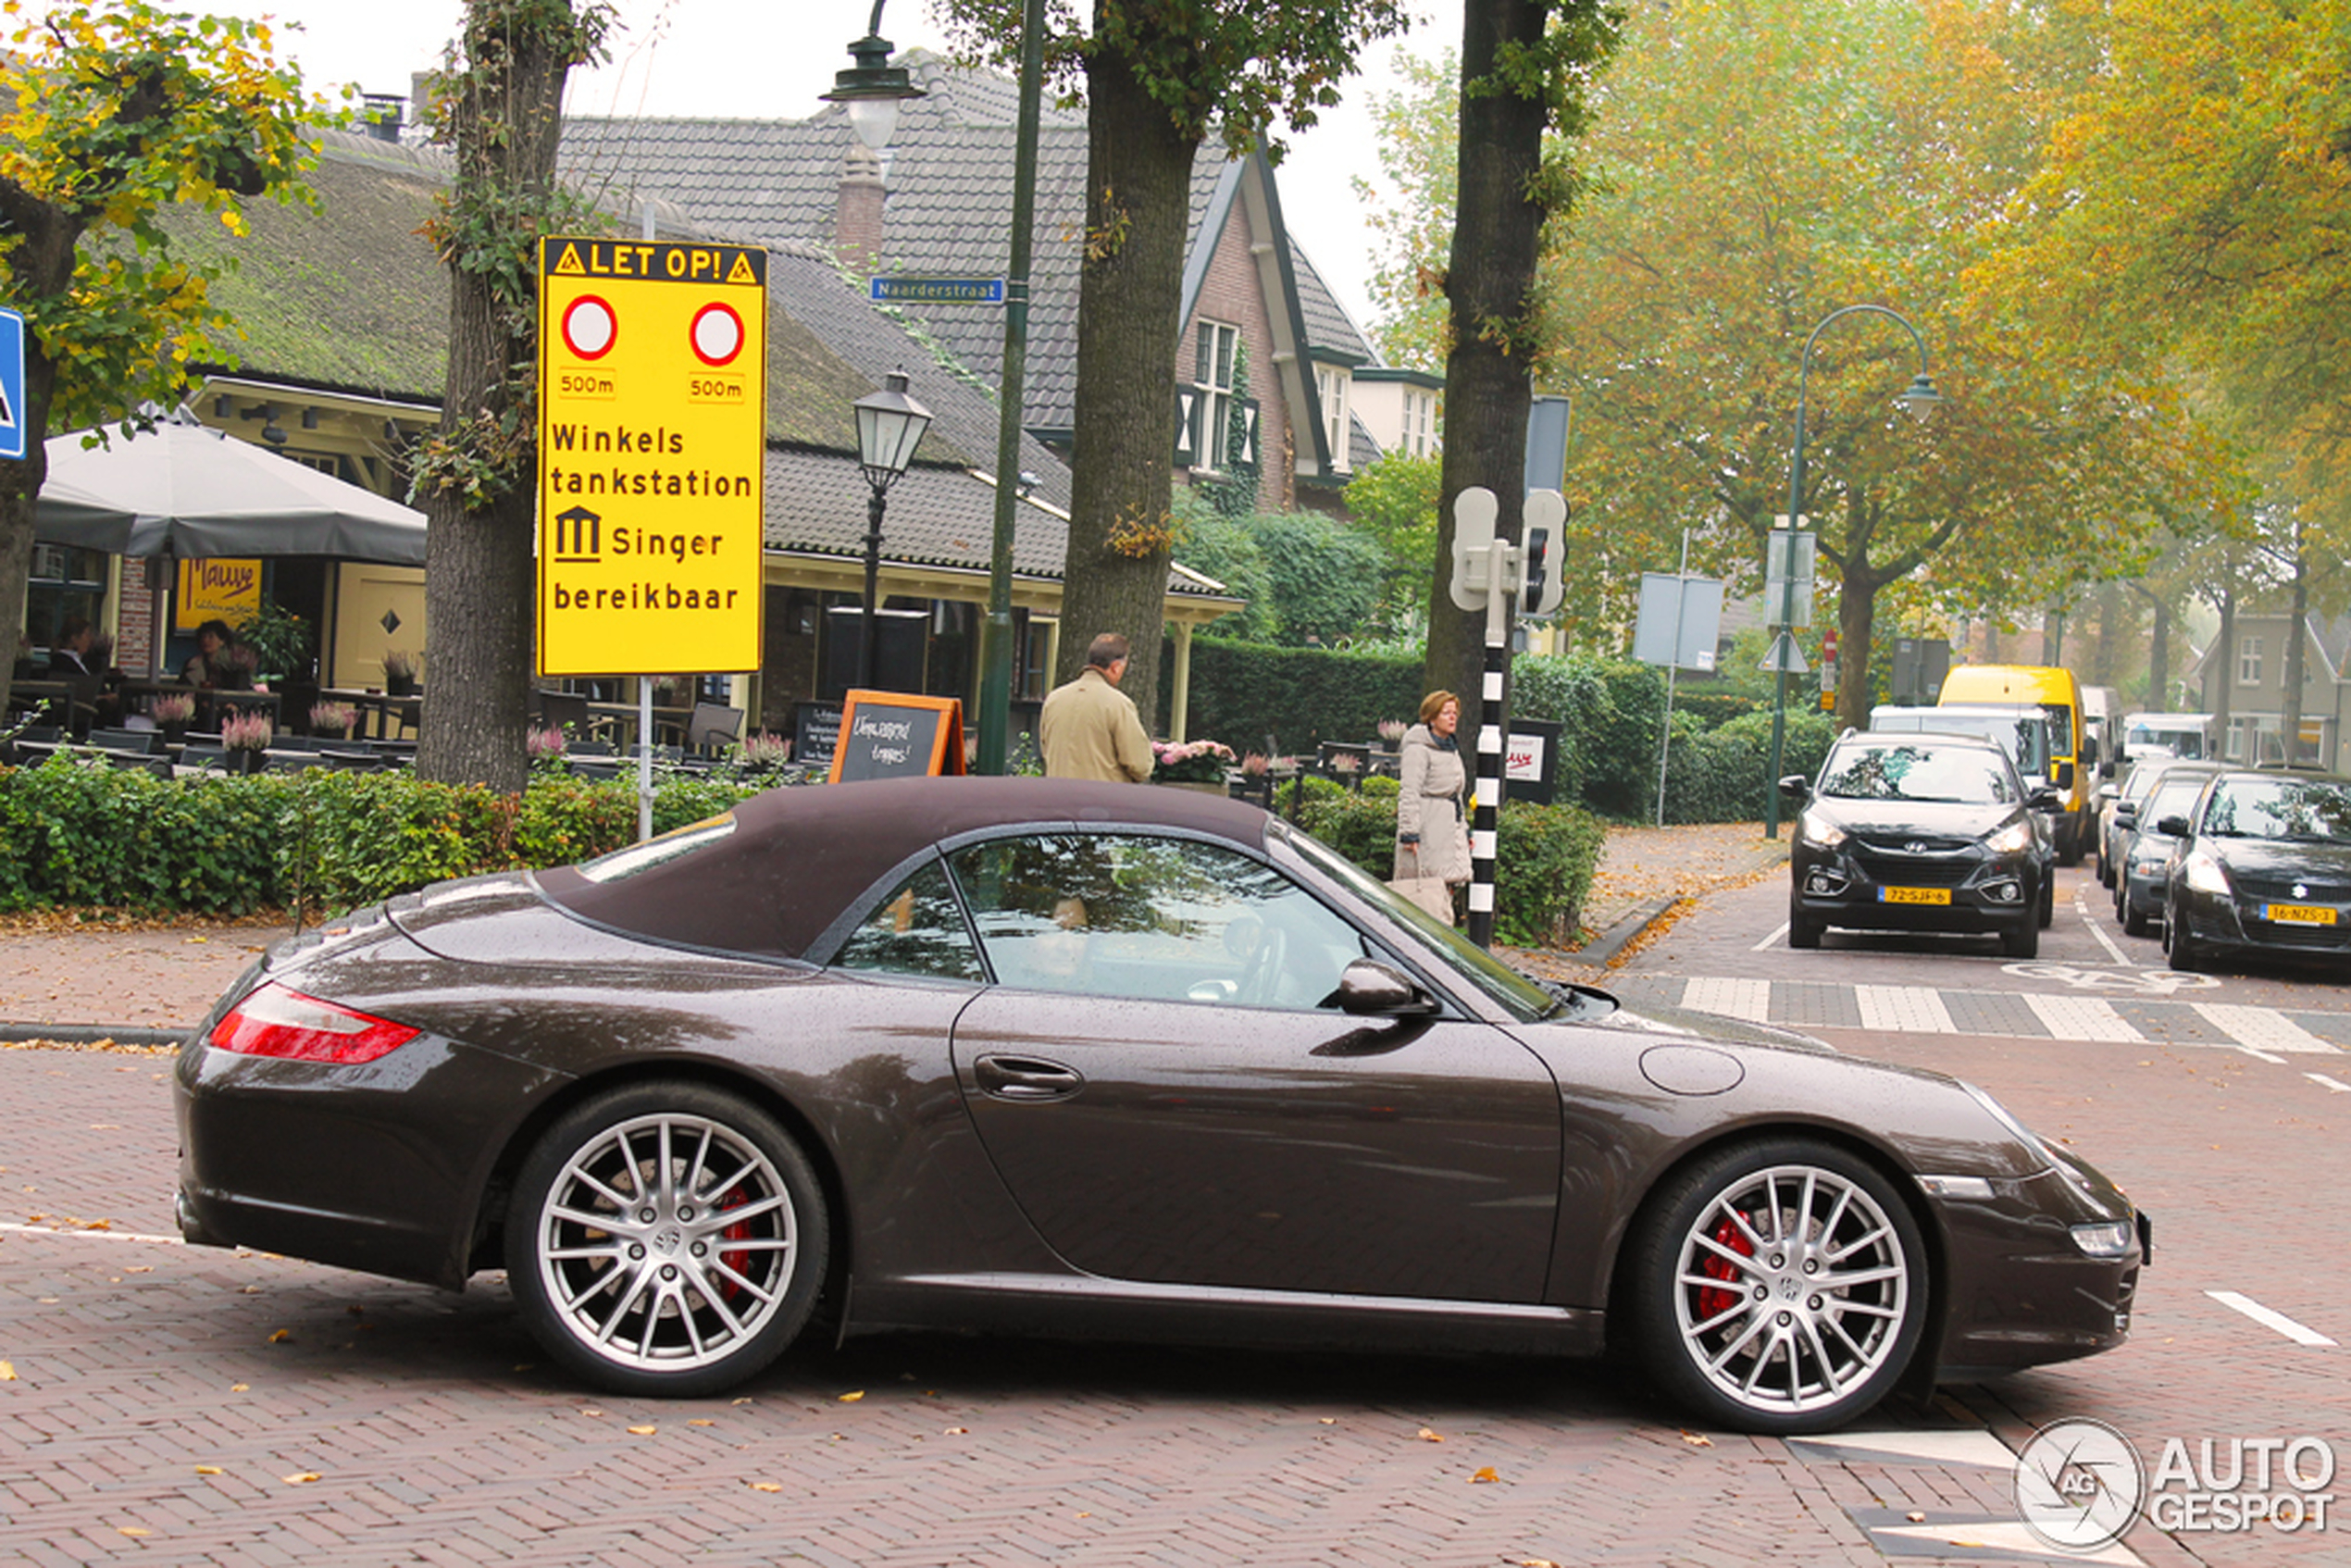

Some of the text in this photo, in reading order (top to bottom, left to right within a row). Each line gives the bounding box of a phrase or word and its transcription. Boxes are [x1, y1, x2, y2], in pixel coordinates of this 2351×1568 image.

[590, 243, 722, 280] LET OP!
[878, 282, 996, 298] Naarderstraat
[561, 376, 614, 392] 500m
[690, 380, 741, 396] 500m
[553, 424, 683, 454] Winkels
[551, 467, 751, 496] tankstation
[612, 528, 723, 564] Singer
[554, 582, 739, 610] bereikbaar
